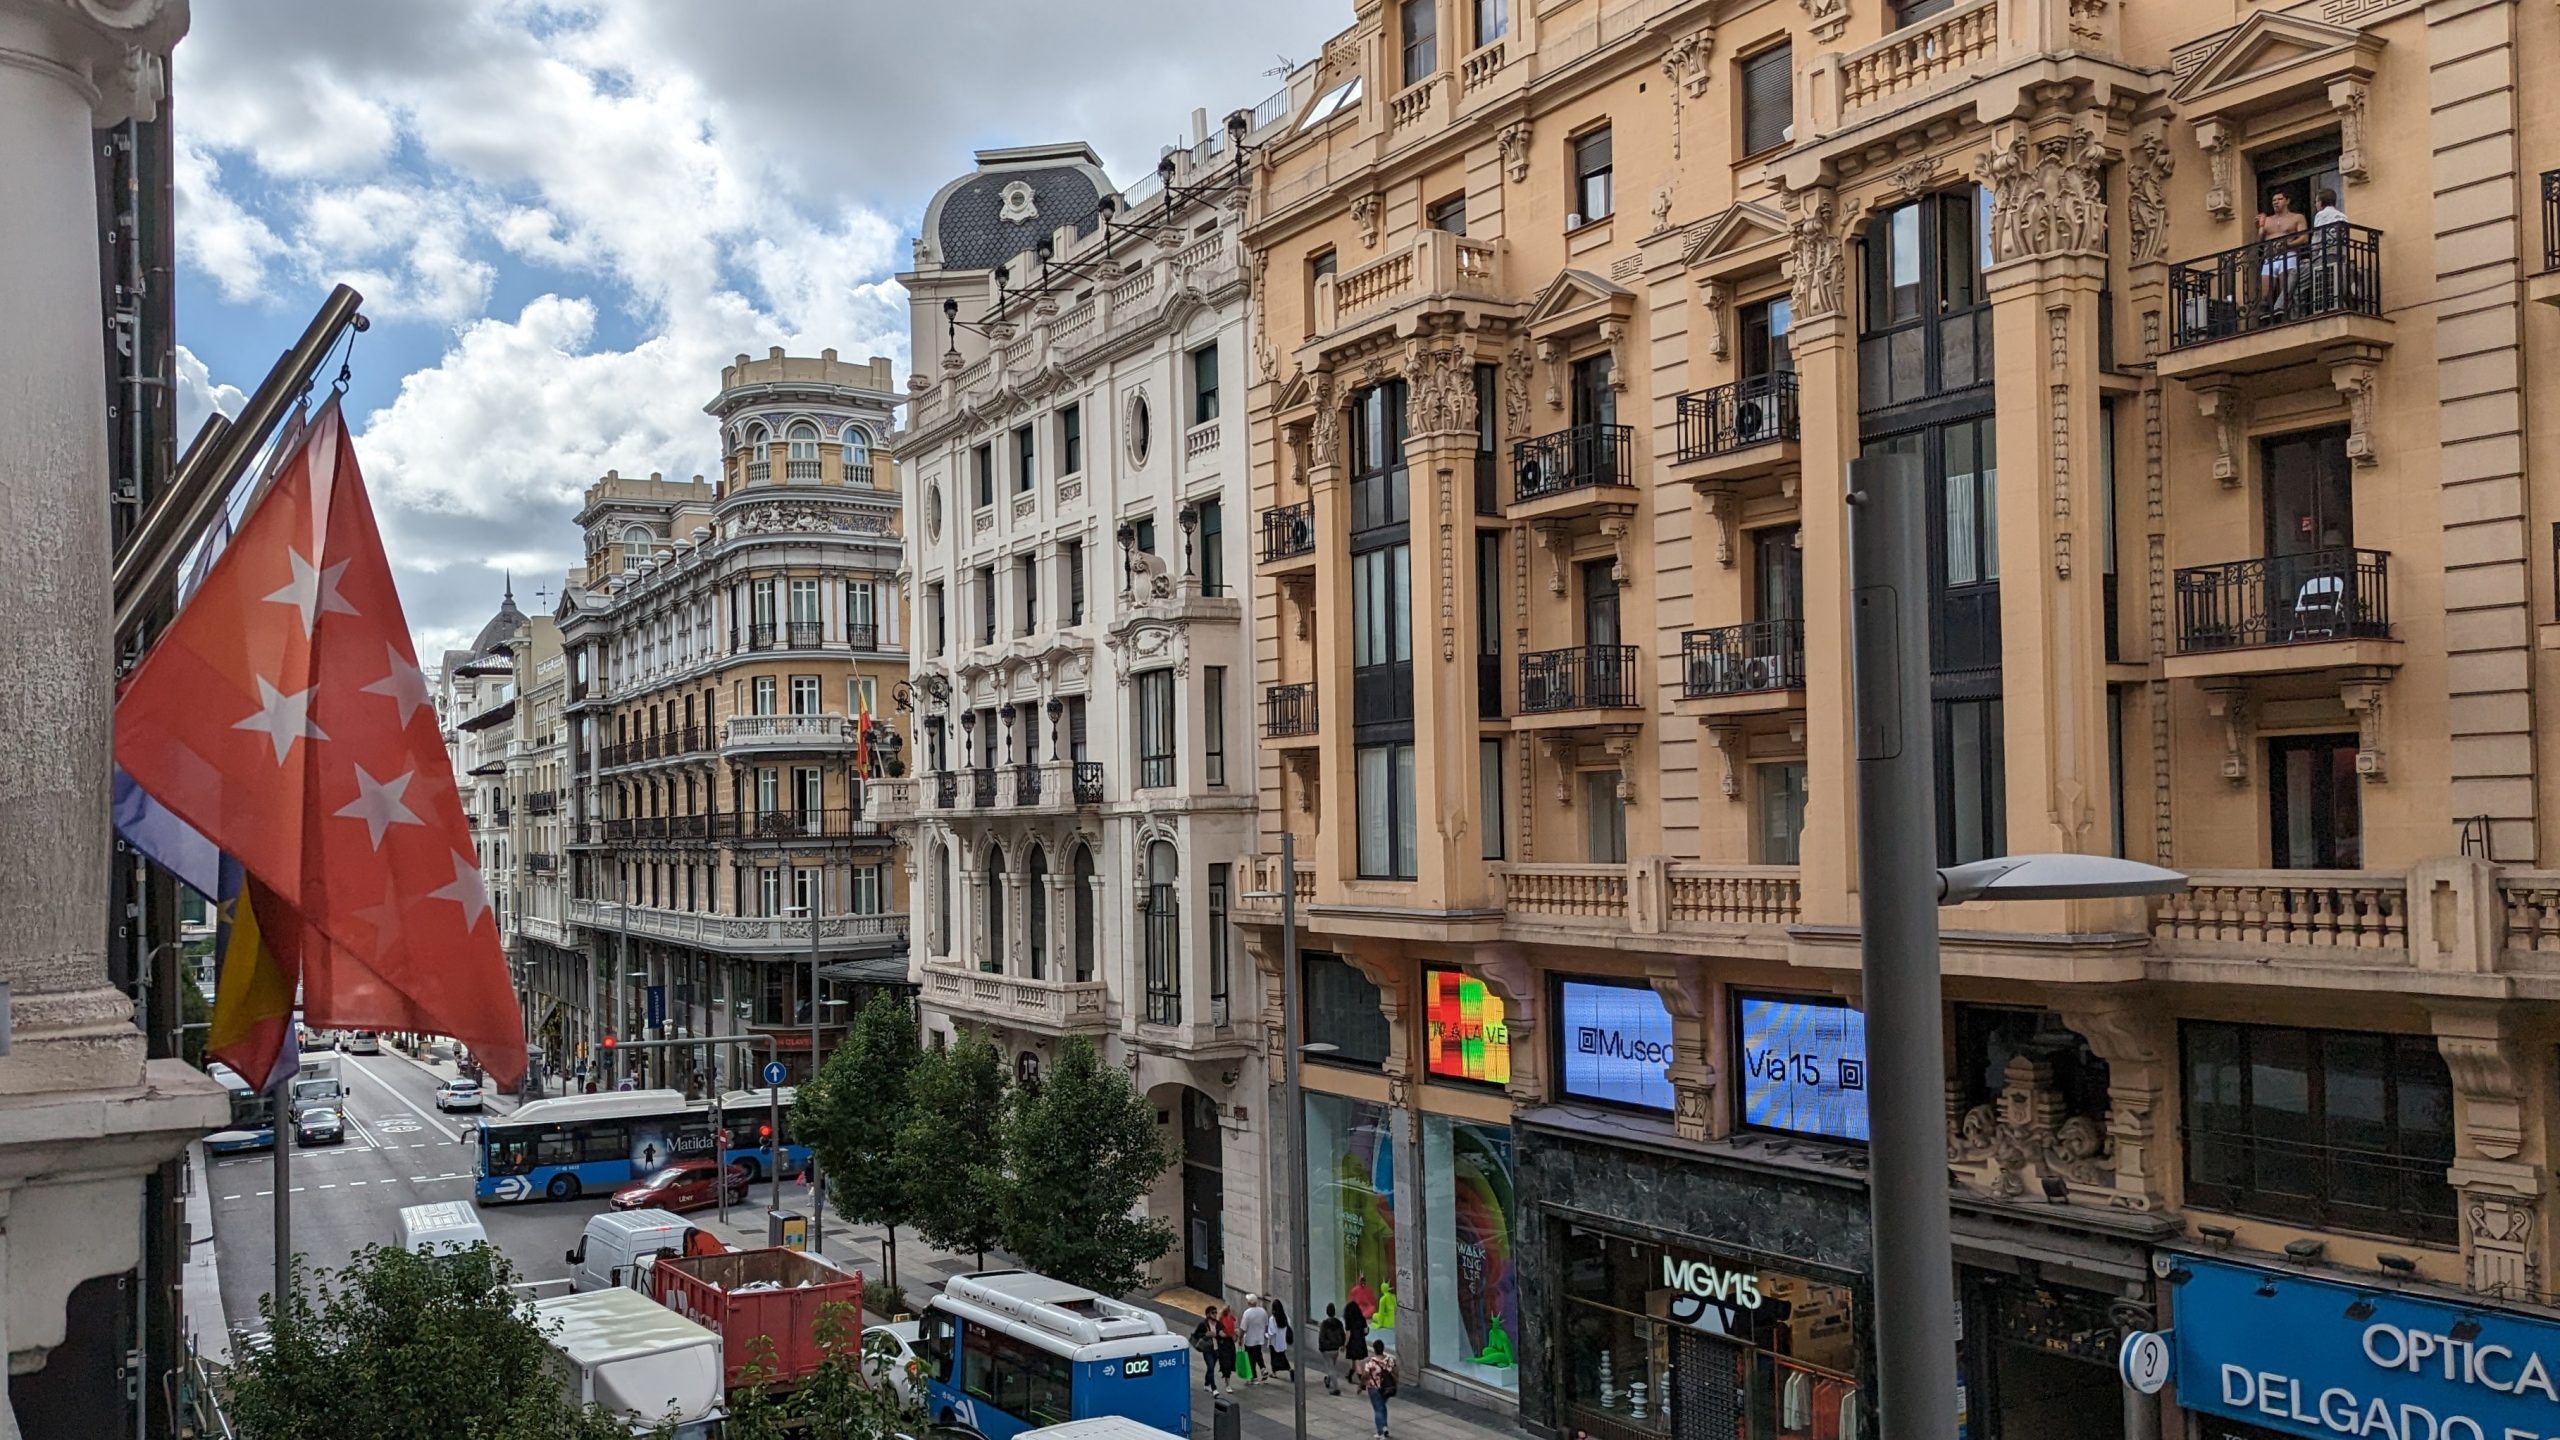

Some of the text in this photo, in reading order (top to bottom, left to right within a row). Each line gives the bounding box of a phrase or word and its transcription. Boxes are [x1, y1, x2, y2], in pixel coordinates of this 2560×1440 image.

[1745, 1048, 1820, 1086] Vía 15
[666, 1136, 714, 1153] Matilda
[678, 1195, 694, 1203] Uber
[1663, 1255, 1761, 1309] MGV15
[1126, 1358, 1176, 1374] 002 9045
[2362, 1323, 2559, 1401] OPTICA
[2222, 1363, 2484, 1440] DELGADO
